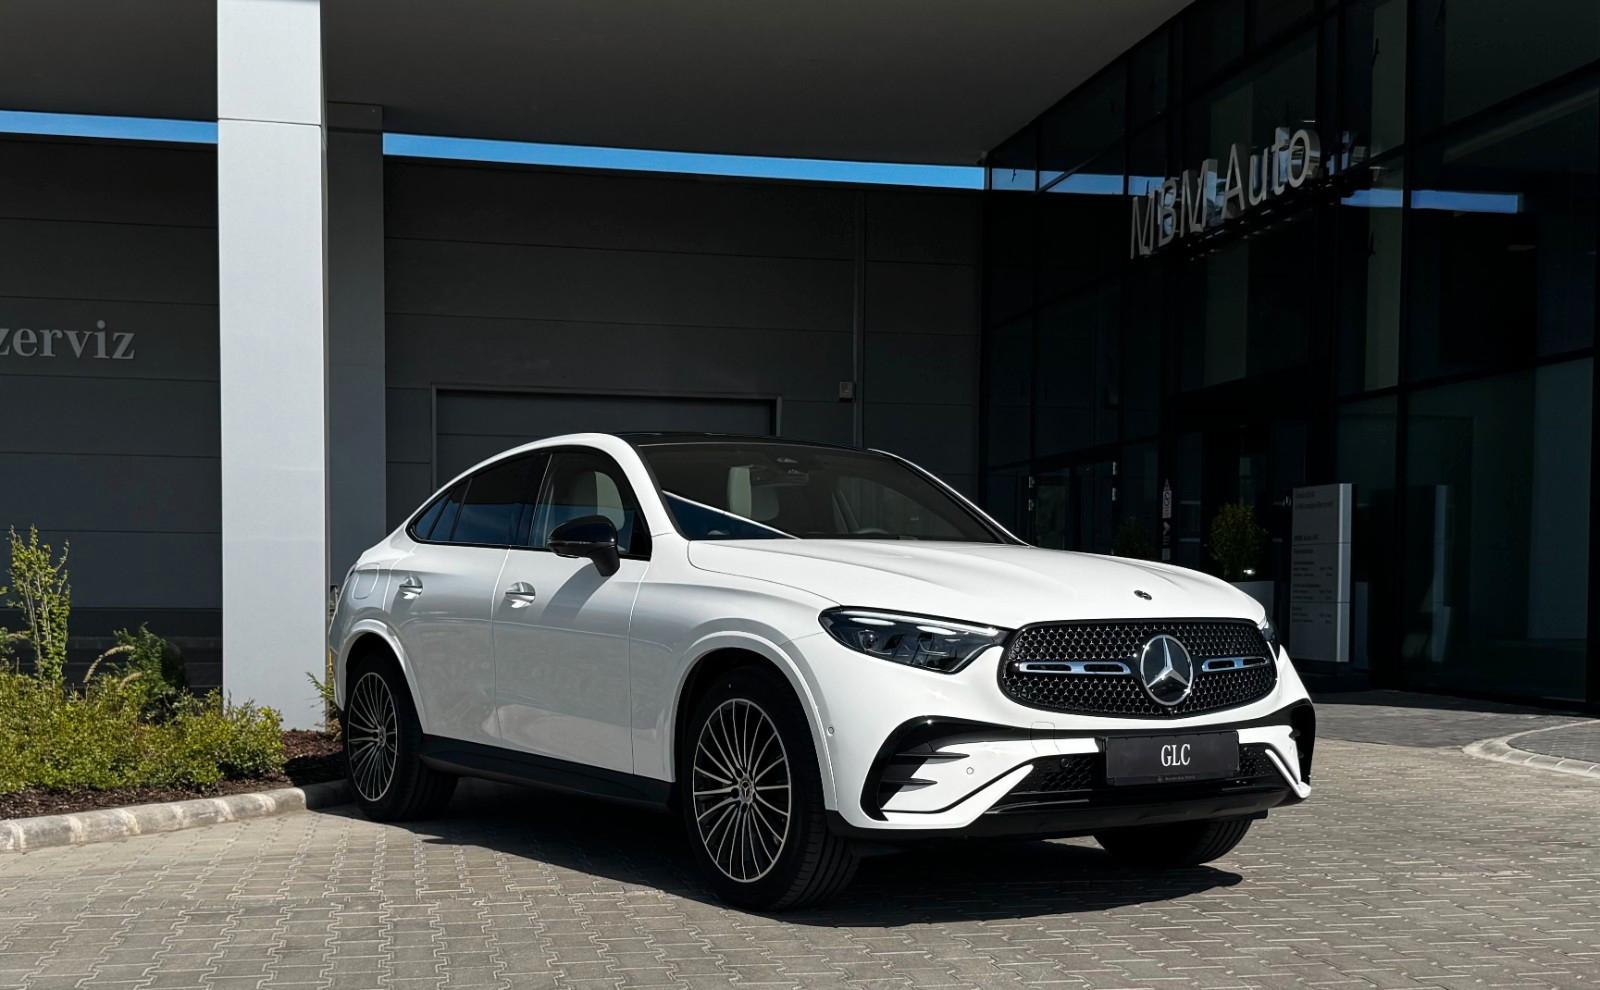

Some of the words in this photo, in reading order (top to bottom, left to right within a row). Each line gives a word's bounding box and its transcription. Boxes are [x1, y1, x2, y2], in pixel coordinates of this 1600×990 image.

[1130, 158, 1216, 260] MBM
[1221, 126, 1320, 219] Auto
[1160, 744, 1191, 767] GLC
